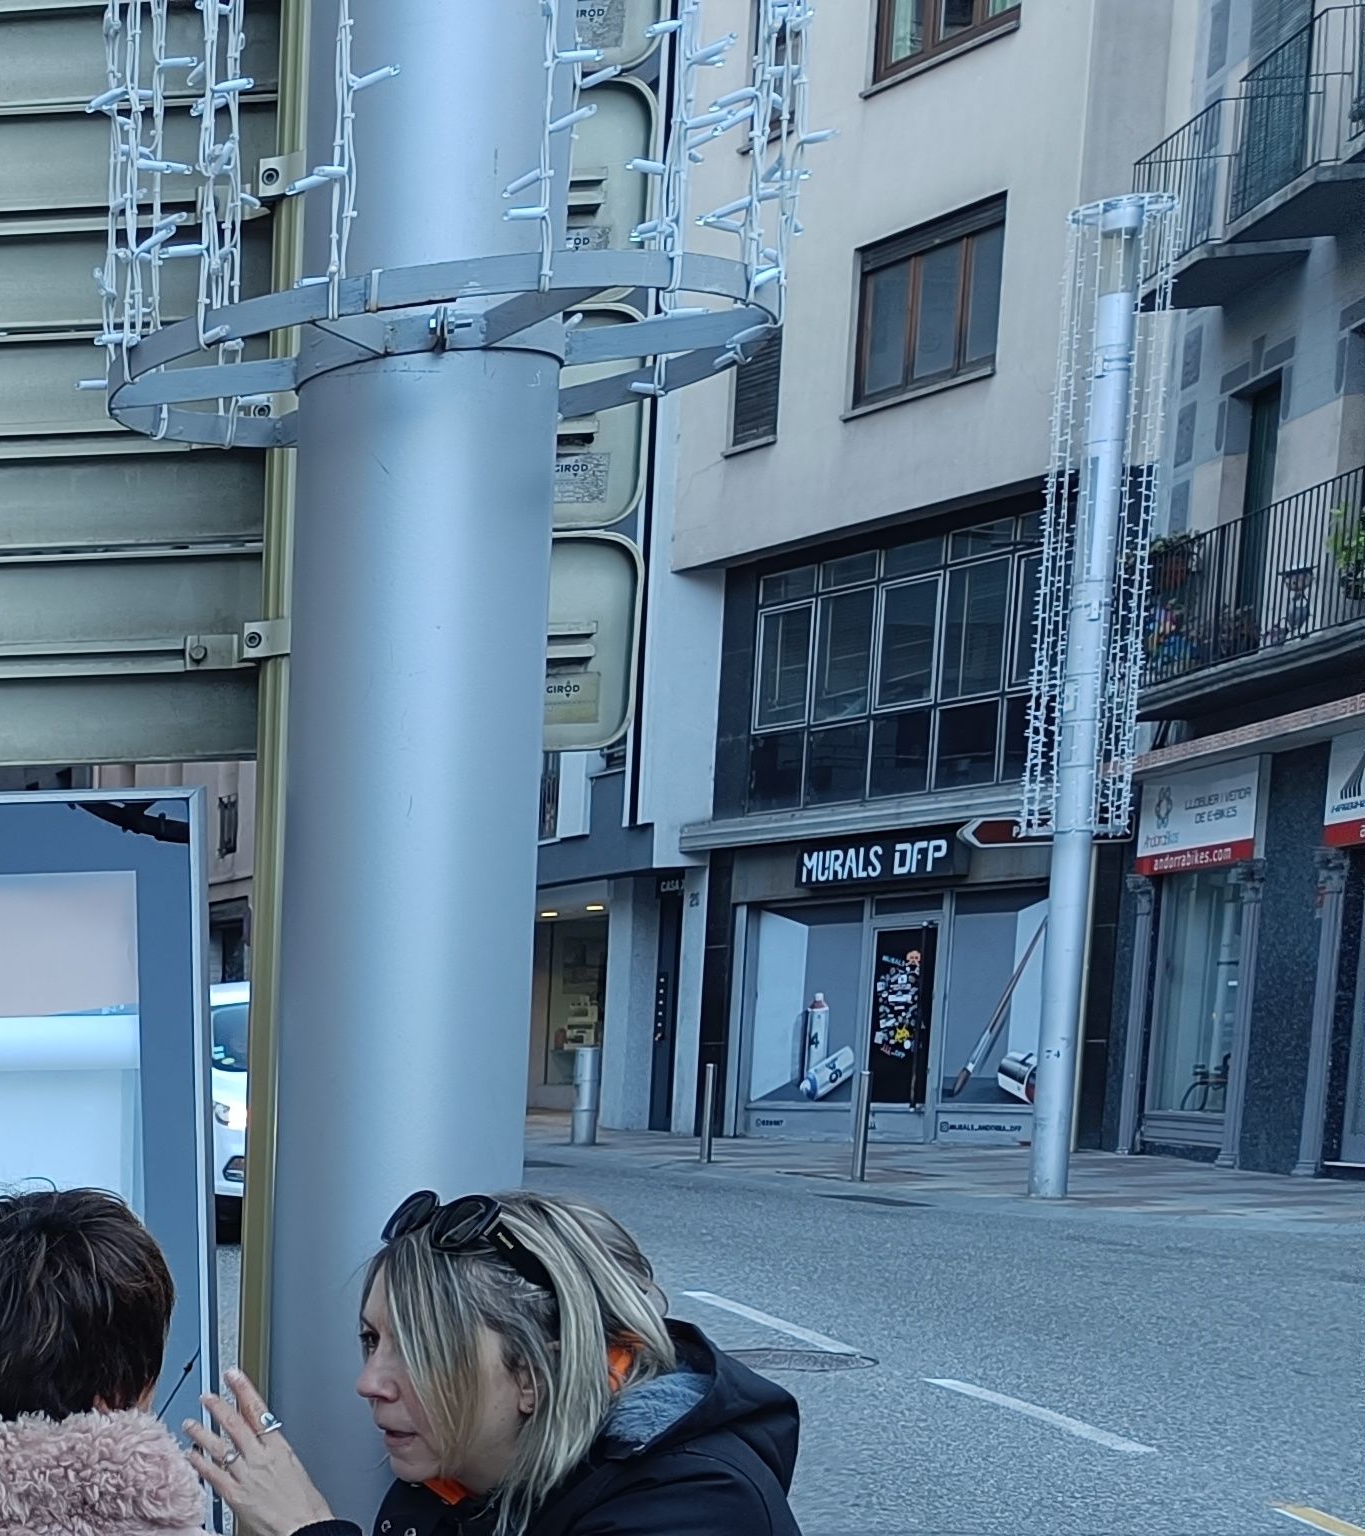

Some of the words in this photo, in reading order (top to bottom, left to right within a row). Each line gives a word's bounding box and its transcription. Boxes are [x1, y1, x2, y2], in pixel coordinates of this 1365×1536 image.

[576, 8, 605, 18] IROD
[546, 684, 580, 694] GIROD
[801, 845, 883, 883] MURALS
[893, 839, 948, 875] DFP
[1153, 847, 1232, 871] andorrabikes.com
